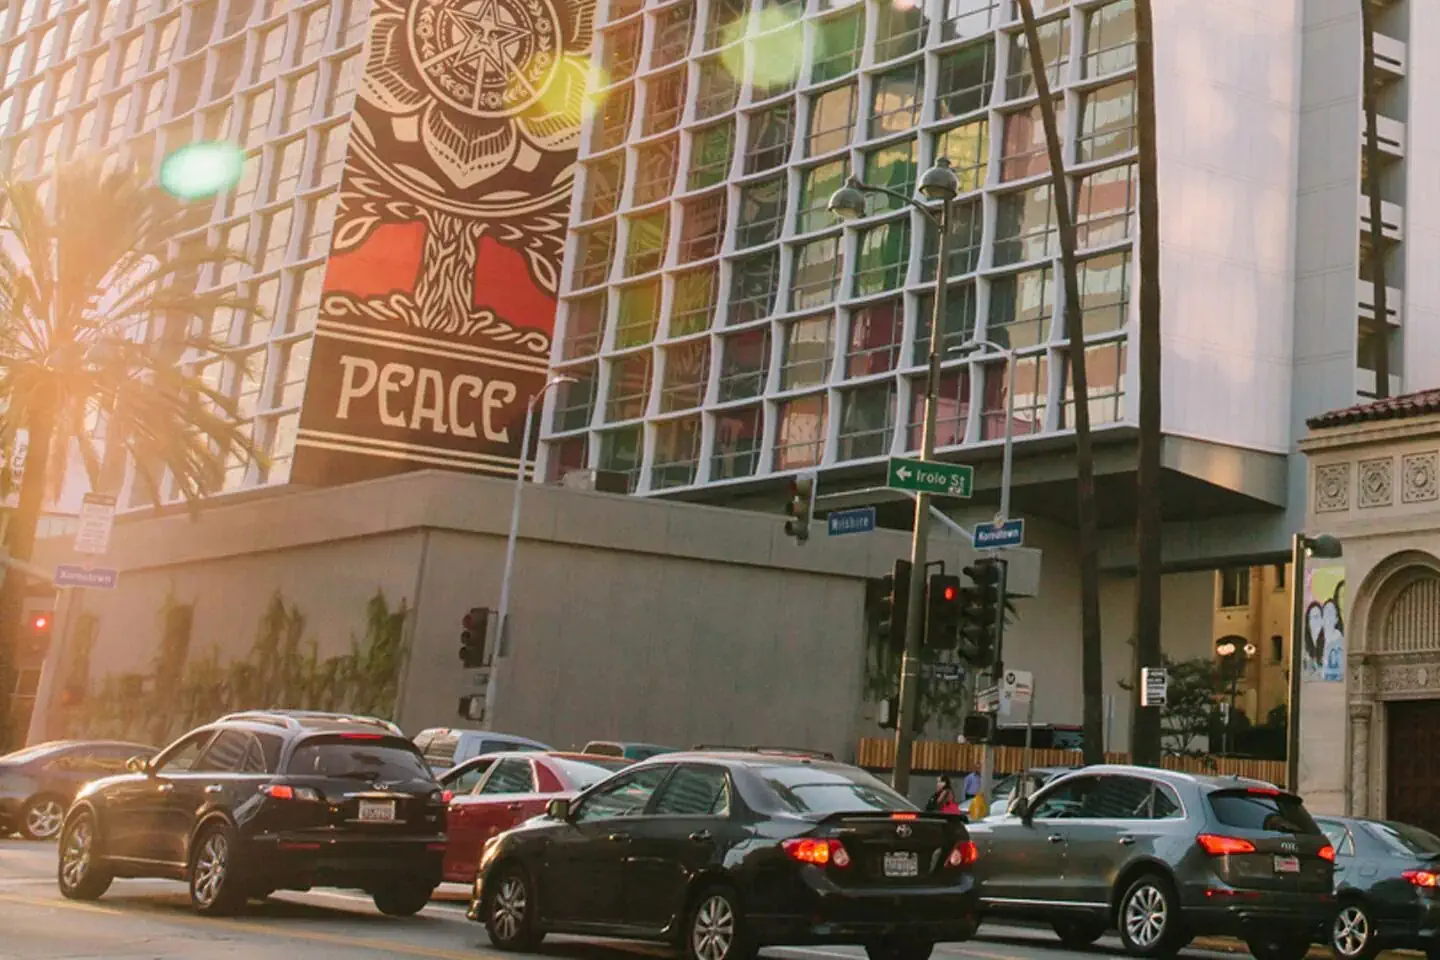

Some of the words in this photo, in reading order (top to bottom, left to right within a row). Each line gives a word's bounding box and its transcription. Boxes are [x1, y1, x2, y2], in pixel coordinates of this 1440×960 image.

[335, 354, 517, 444] PEACE
[916, 469, 947, 485] Irolo
[950, 474, 966, 488] St
